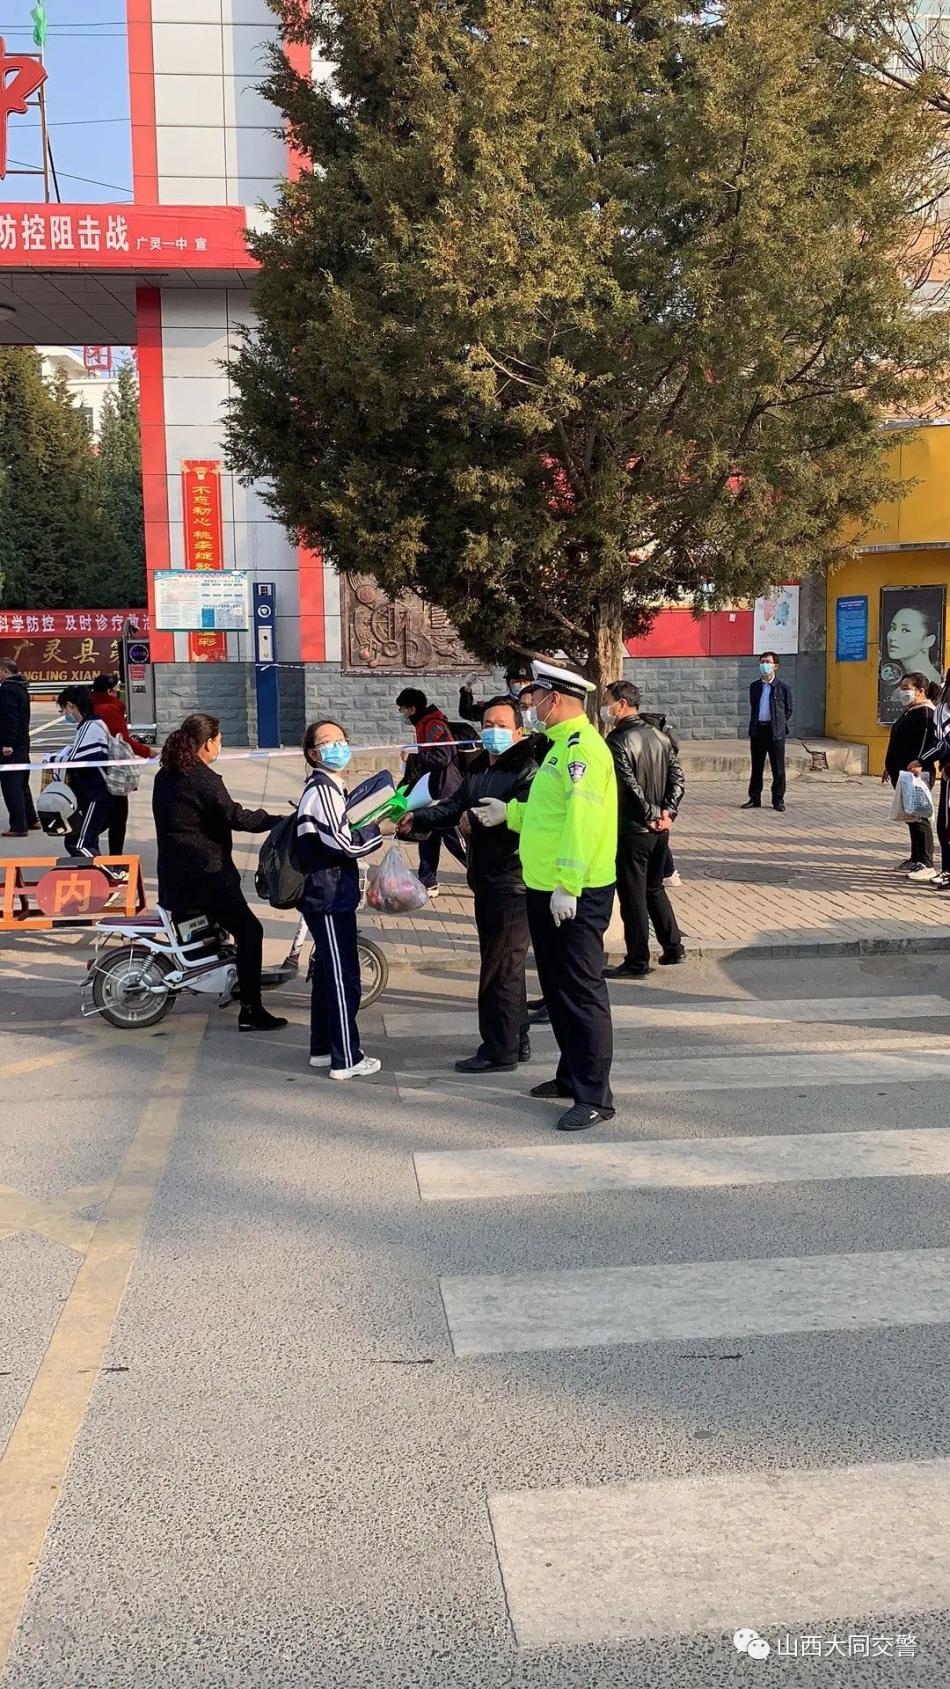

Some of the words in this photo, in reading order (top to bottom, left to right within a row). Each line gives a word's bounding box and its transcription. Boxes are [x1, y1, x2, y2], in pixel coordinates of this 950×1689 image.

[0, 213, 130, 252] 防控阻击战
[136, 236, 188, 251] 广灵一中
[194, 237, 208, 251] 宣
[0, 615, 56, 633] 科学防控
[18, 671, 68, 682] NGLING
[53, 873, 92, 912] 内
